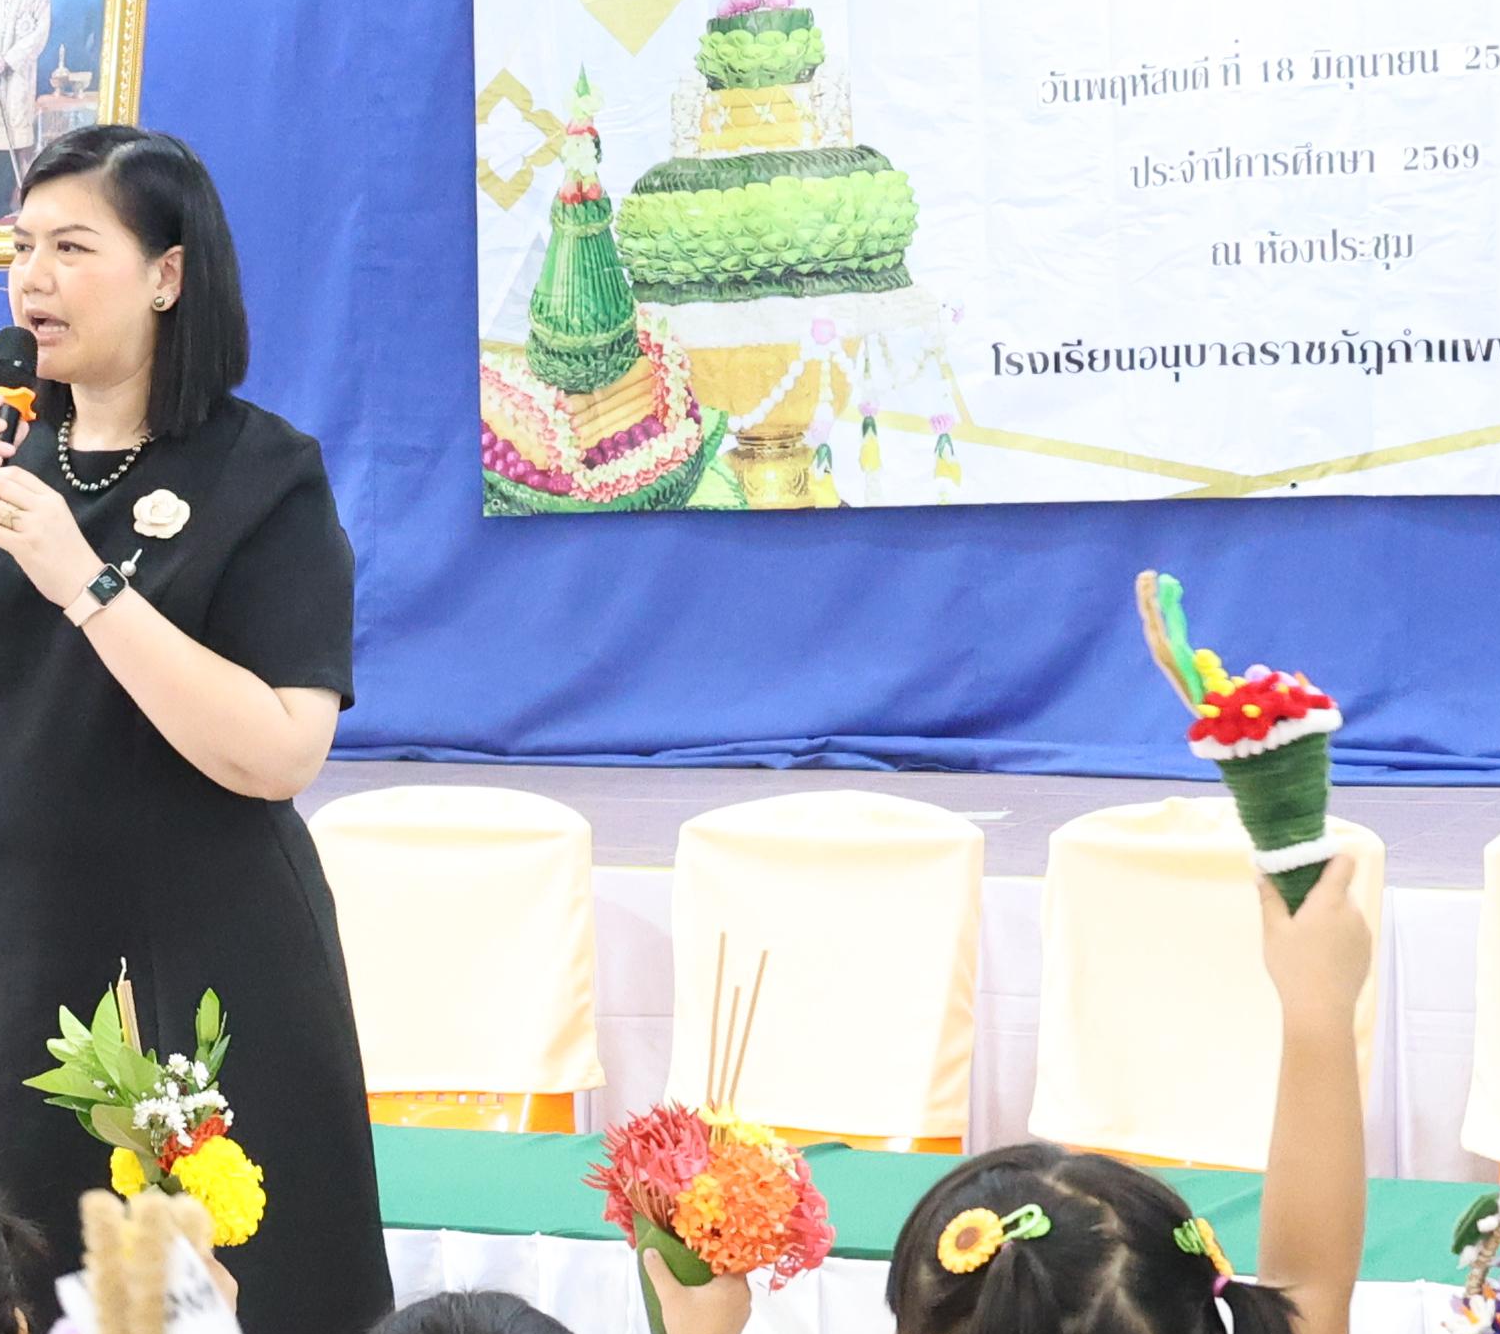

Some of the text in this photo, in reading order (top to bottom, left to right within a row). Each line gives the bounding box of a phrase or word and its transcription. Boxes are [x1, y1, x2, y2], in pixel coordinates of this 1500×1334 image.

[1041, 56, 1209, 107] วันพฤหัสบดี
[1220, 38, 1241, 87] ที่
[1261, 57, 1295, 84] 18
[1310, 48, 1440, 90] มิถุนายน
[1130, 142, 1480, 189] ประจำปีการศึกษา 2569
[1211, 228, 1413, 271] ณ ห้องประชุม
